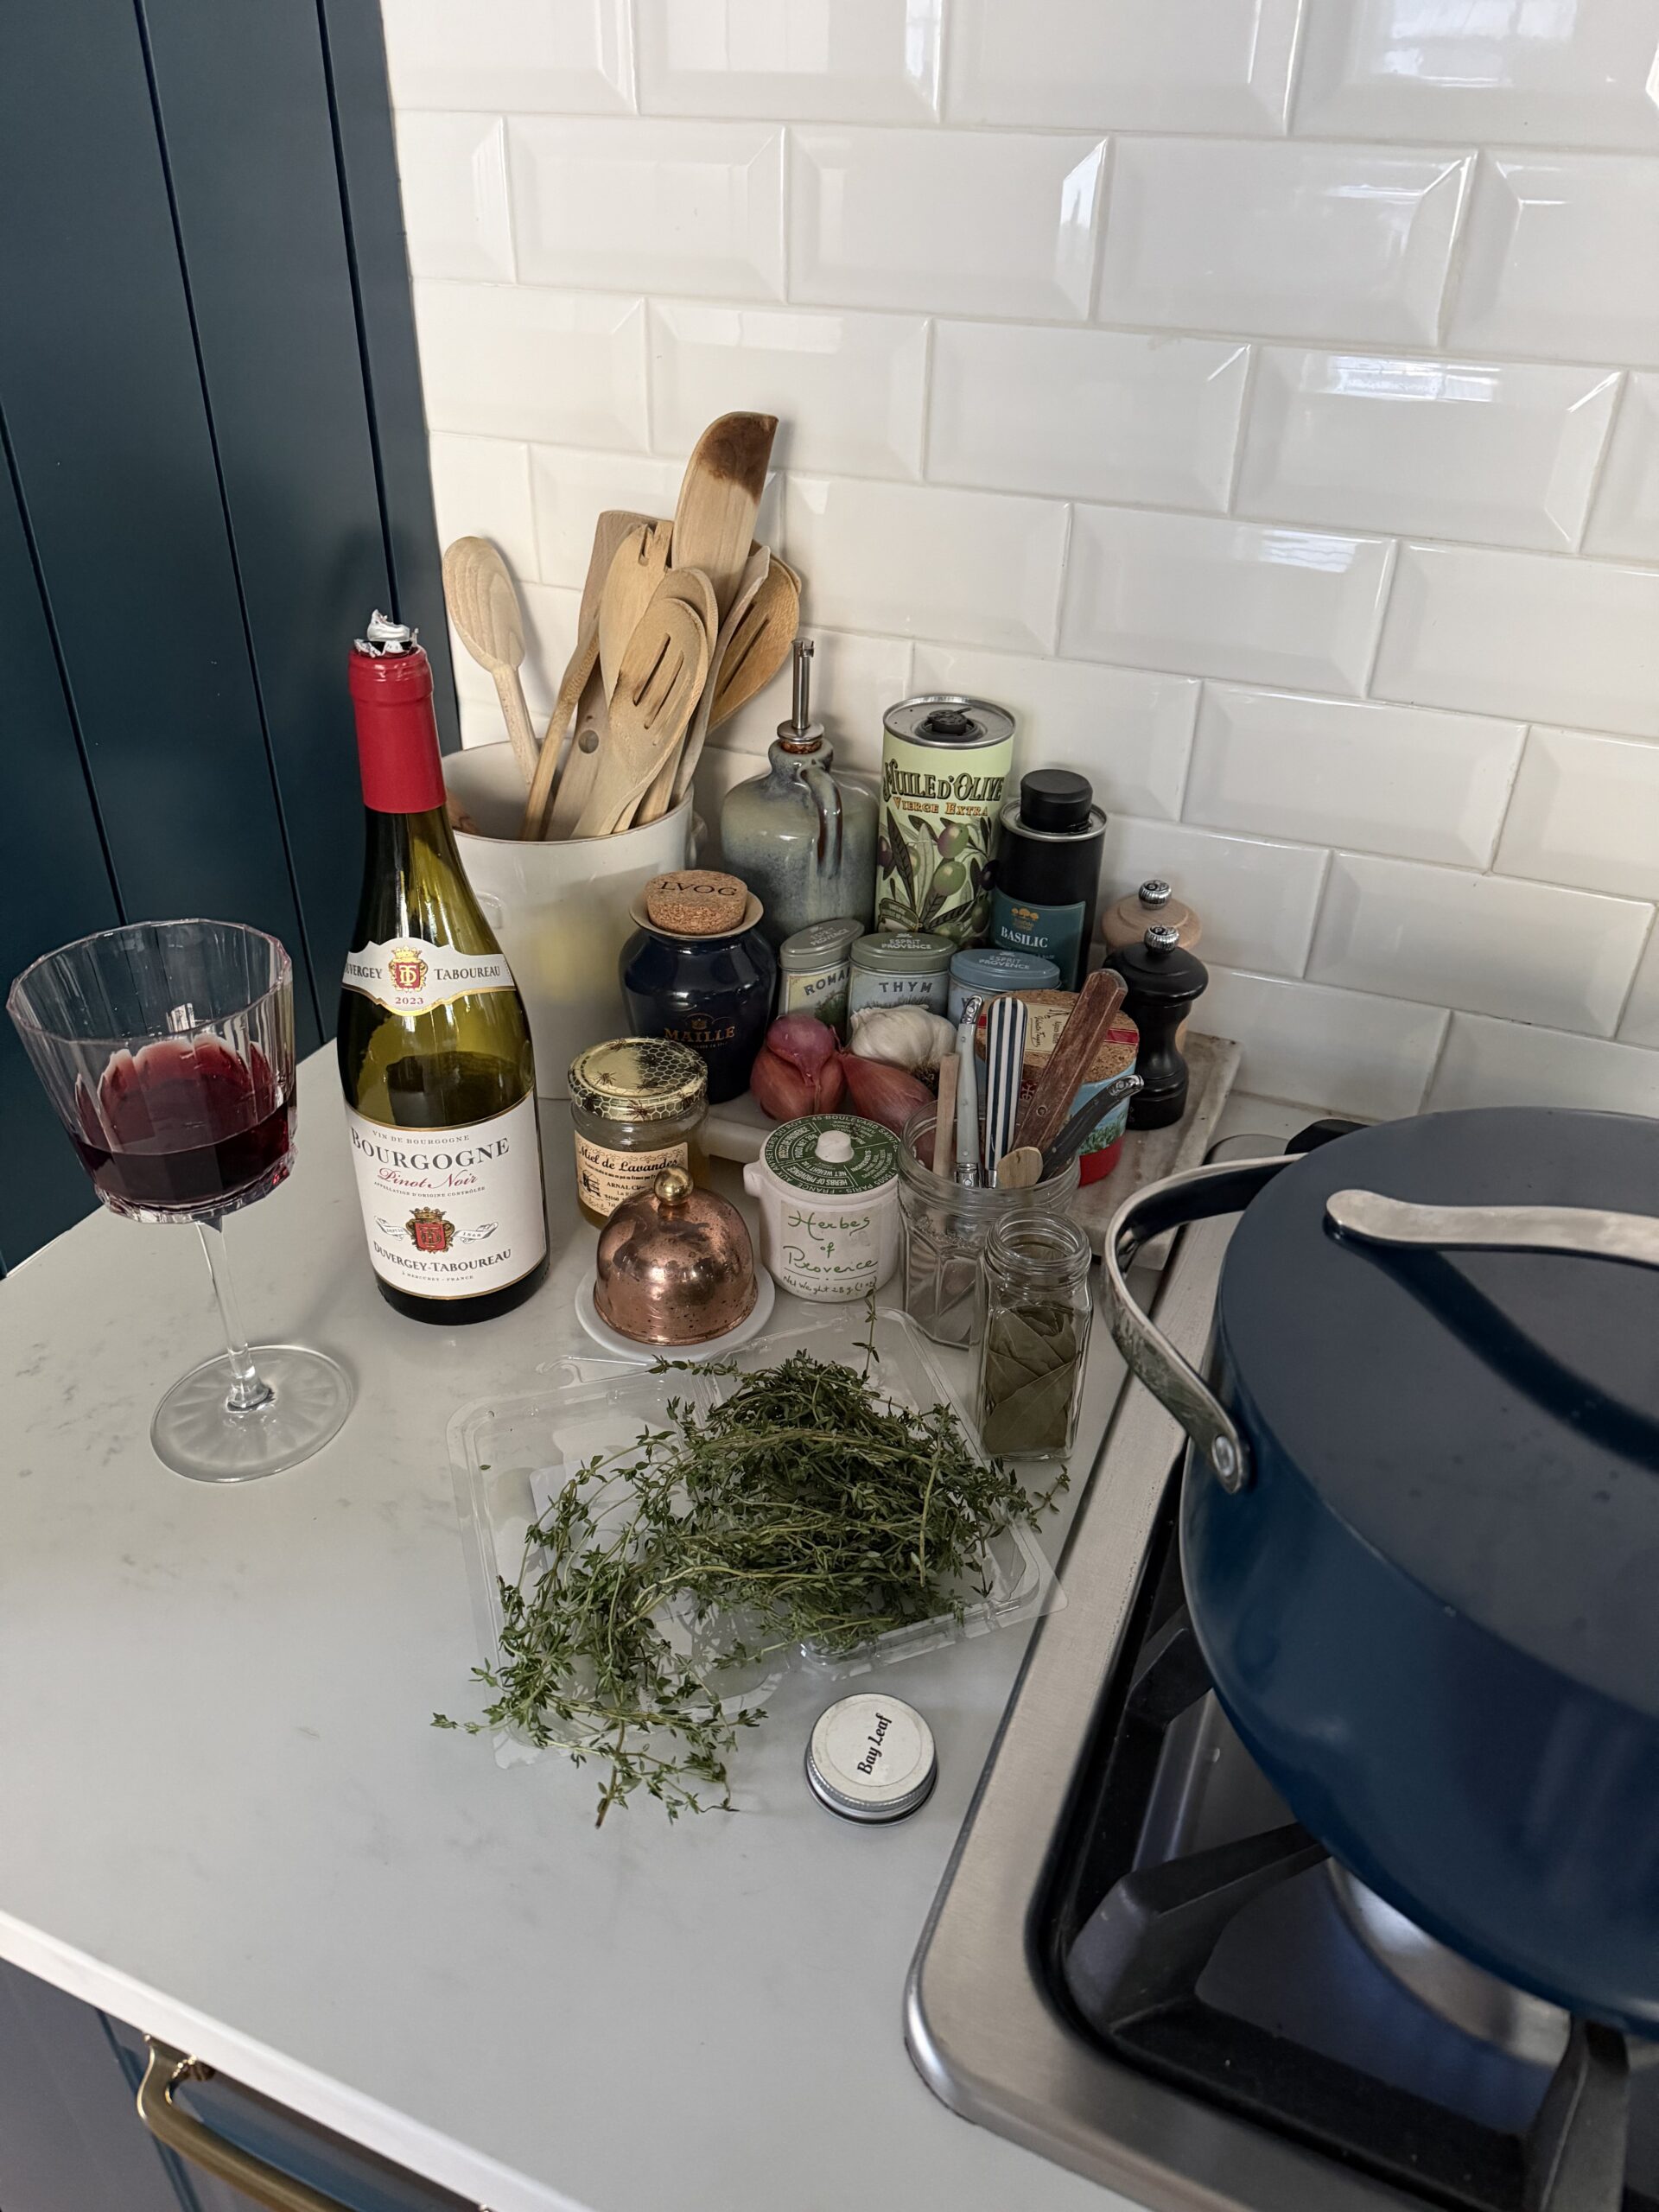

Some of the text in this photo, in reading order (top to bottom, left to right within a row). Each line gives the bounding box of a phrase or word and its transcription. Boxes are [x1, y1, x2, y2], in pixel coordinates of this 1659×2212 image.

[893, 796, 988, 817] VIERGE EXTRA
[1001, 925, 1049, 949] BASILIC
[978, 958, 1030, 969] PROVENCE
[989, 955, 1021, 963] ESPRIT
[434, 965, 501, 981] TABOUREAU
[879, 982, 932, 994] THYM
[664, 1026, 735, 1042] MAILLE
[776, 1128, 786, 1137] DU
[786, 1119, 803, 1129] ROY
[825, 1115, 879, 1129] BOULEVARD
[372, 1130, 387, 1140] VIN
[407, 1135, 470, 1145] BOURGOGNE
[351, 1126, 510, 1171] BOURGOGNE
[580, 1146, 600, 1164] Miel
[601, 1158, 615, 1169] de
[619, 1158, 677, 1172] Lavandes
[377, 1167, 479, 1189] Pinot Noir
[787, 1166, 817, 1183] PROVENCE
[810, 1166, 836, 1176] WEIGHT
[798, 1182, 836, 1194] FRANCE
[826, 1178, 848, 1186] HERBS
[846, 1184, 874, 1194] PARIS
[787, 1210, 870, 1241] Herbes
[373, 1241, 512, 1272] DUVERGEY-TABOUREAU
[820, 1242, 836, 1258] of
[783, 1245, 879, 1273] Provence
[857, 1712, 893, 1775] Bay Leaf
